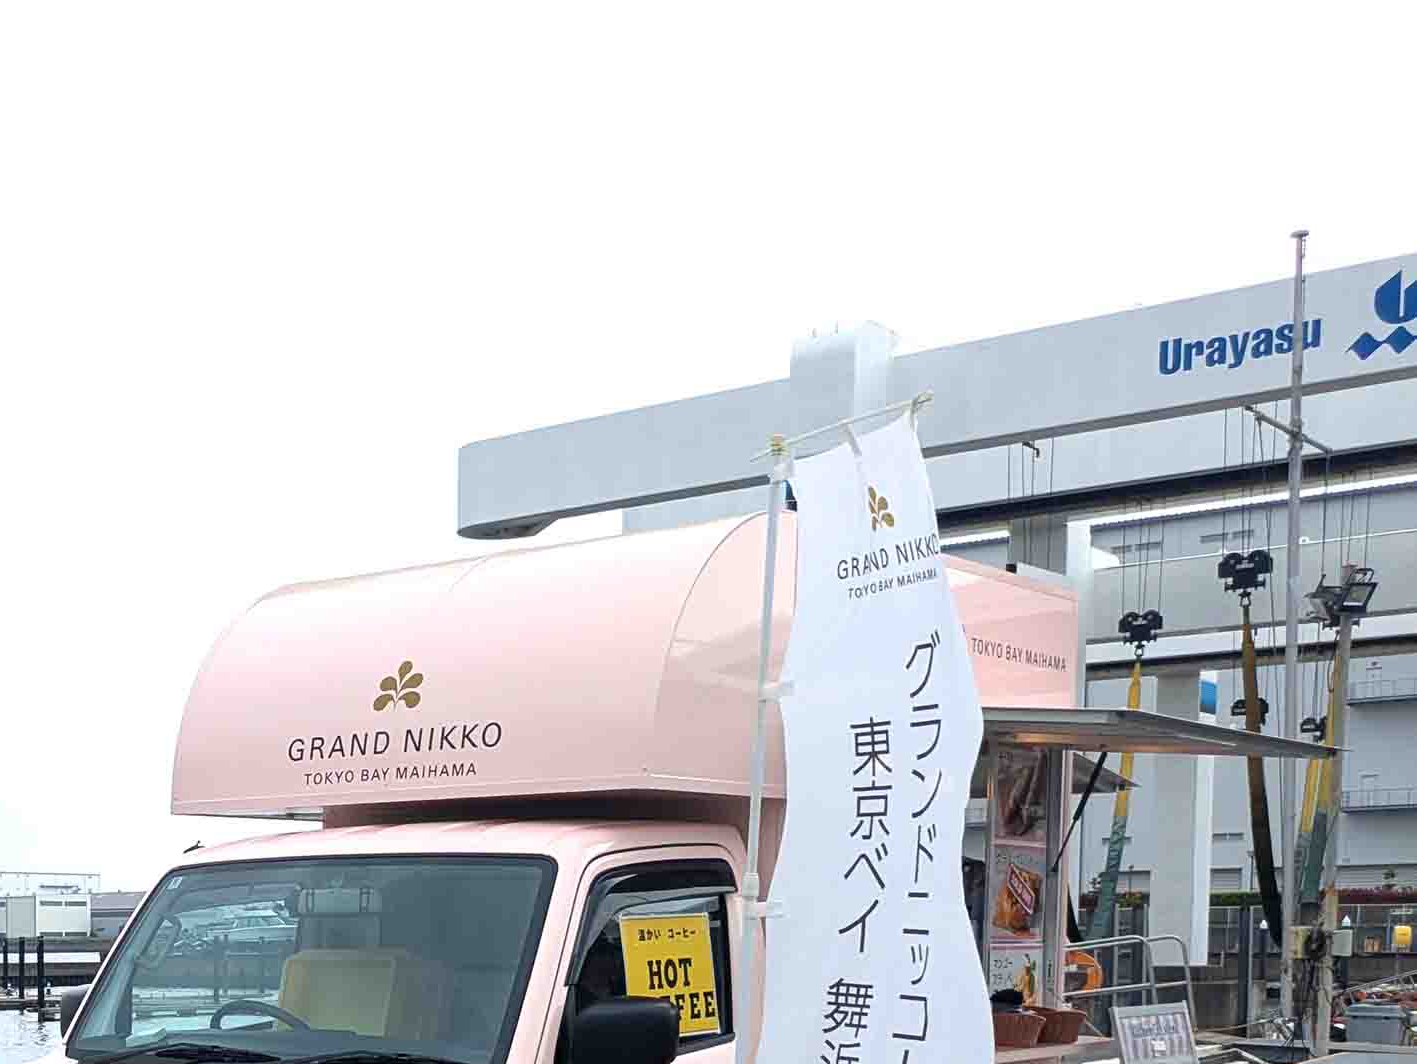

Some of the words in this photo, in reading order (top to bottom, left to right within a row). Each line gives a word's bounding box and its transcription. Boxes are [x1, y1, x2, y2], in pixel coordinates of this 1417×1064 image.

[1158, 318, 1322, 376] Urayasu
[837, 547, 889, 580] GRAND
[895, 532, 939, 566] NIKKO
[847, 582, 877, 600] TOYO
[878, 578, 894, 592] BAY
[971, 637, 1003, 659] TOKYO
[1005, 644, 1023, 663] BAY
[1025, 648, 1067, 672] MAIHAMA
[288, 731, 391, 762] GRAND
[403, 721, 503, 753] NIKKO
[304, 770, 355, 786] TOKYO
[360, 767, 390, 782] BAY
[396, 763, 478, 780] MAIHAMA
[837, 716, 893, 953] 東京ベイ
[667, 927, 697, 939] コーヒー
[647, 957, 693, 990] HOT
[674, 991, 716, 1022] FEE
